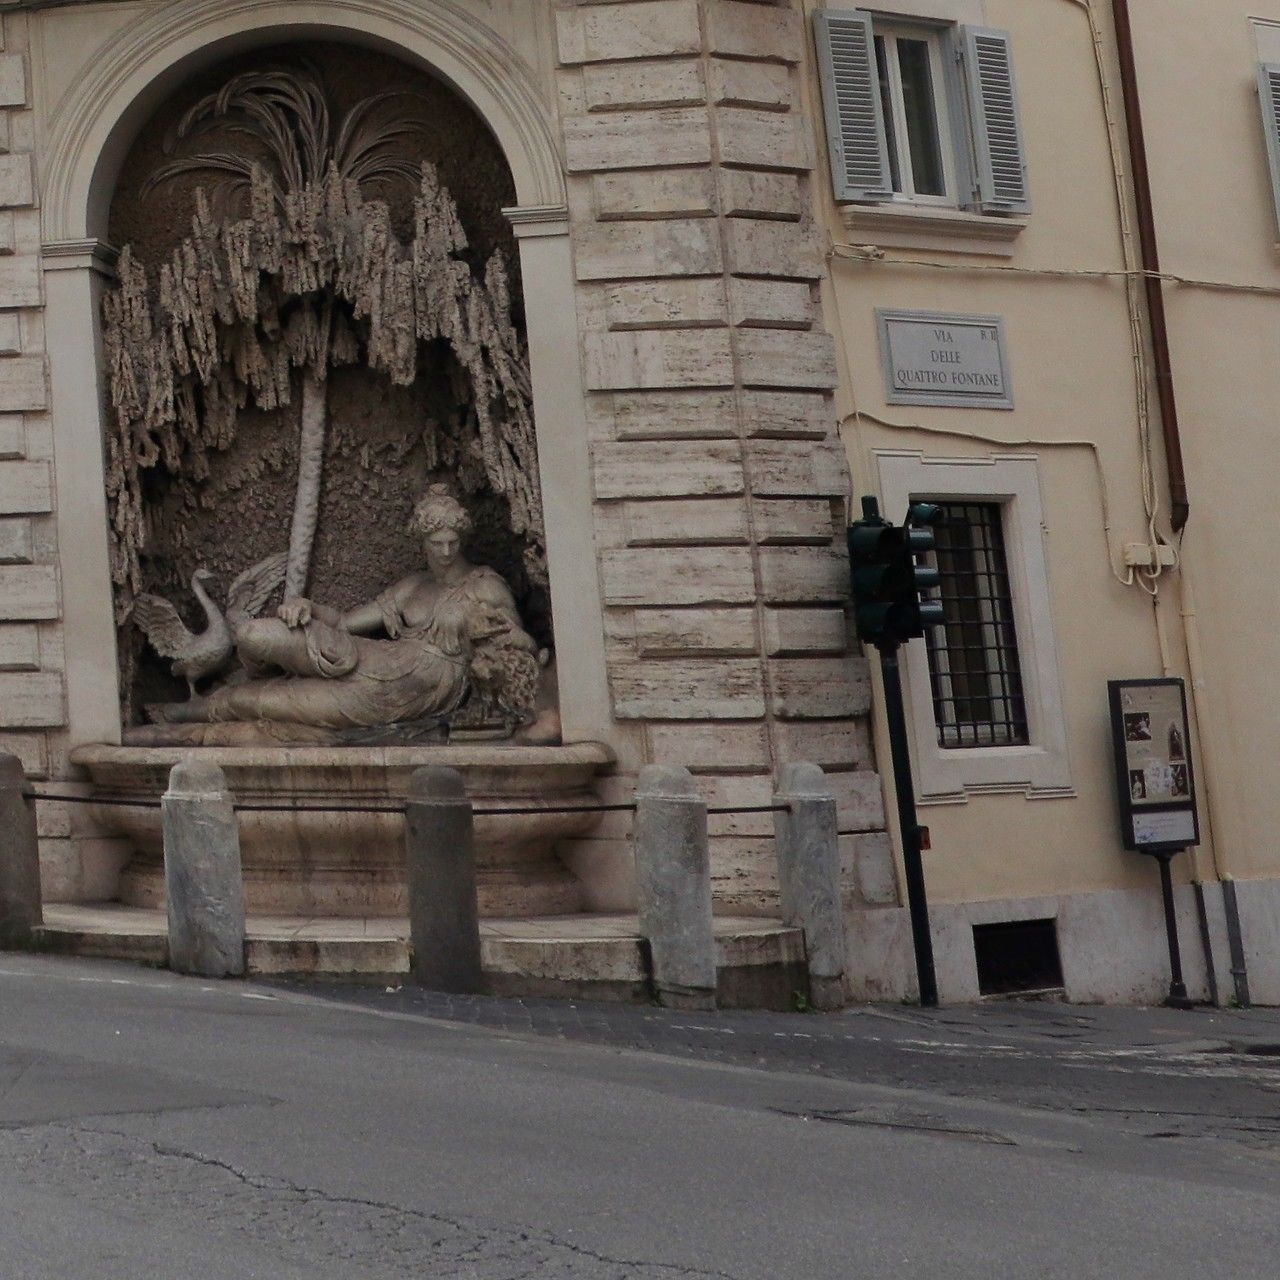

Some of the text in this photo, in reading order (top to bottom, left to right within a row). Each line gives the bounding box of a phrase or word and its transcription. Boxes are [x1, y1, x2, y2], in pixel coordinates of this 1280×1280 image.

[934, 329, 953, 343] VIA
[931, 350, 961, 363] DELLE
[897, 369, 1000, 386] QUATTRO FONTANE
